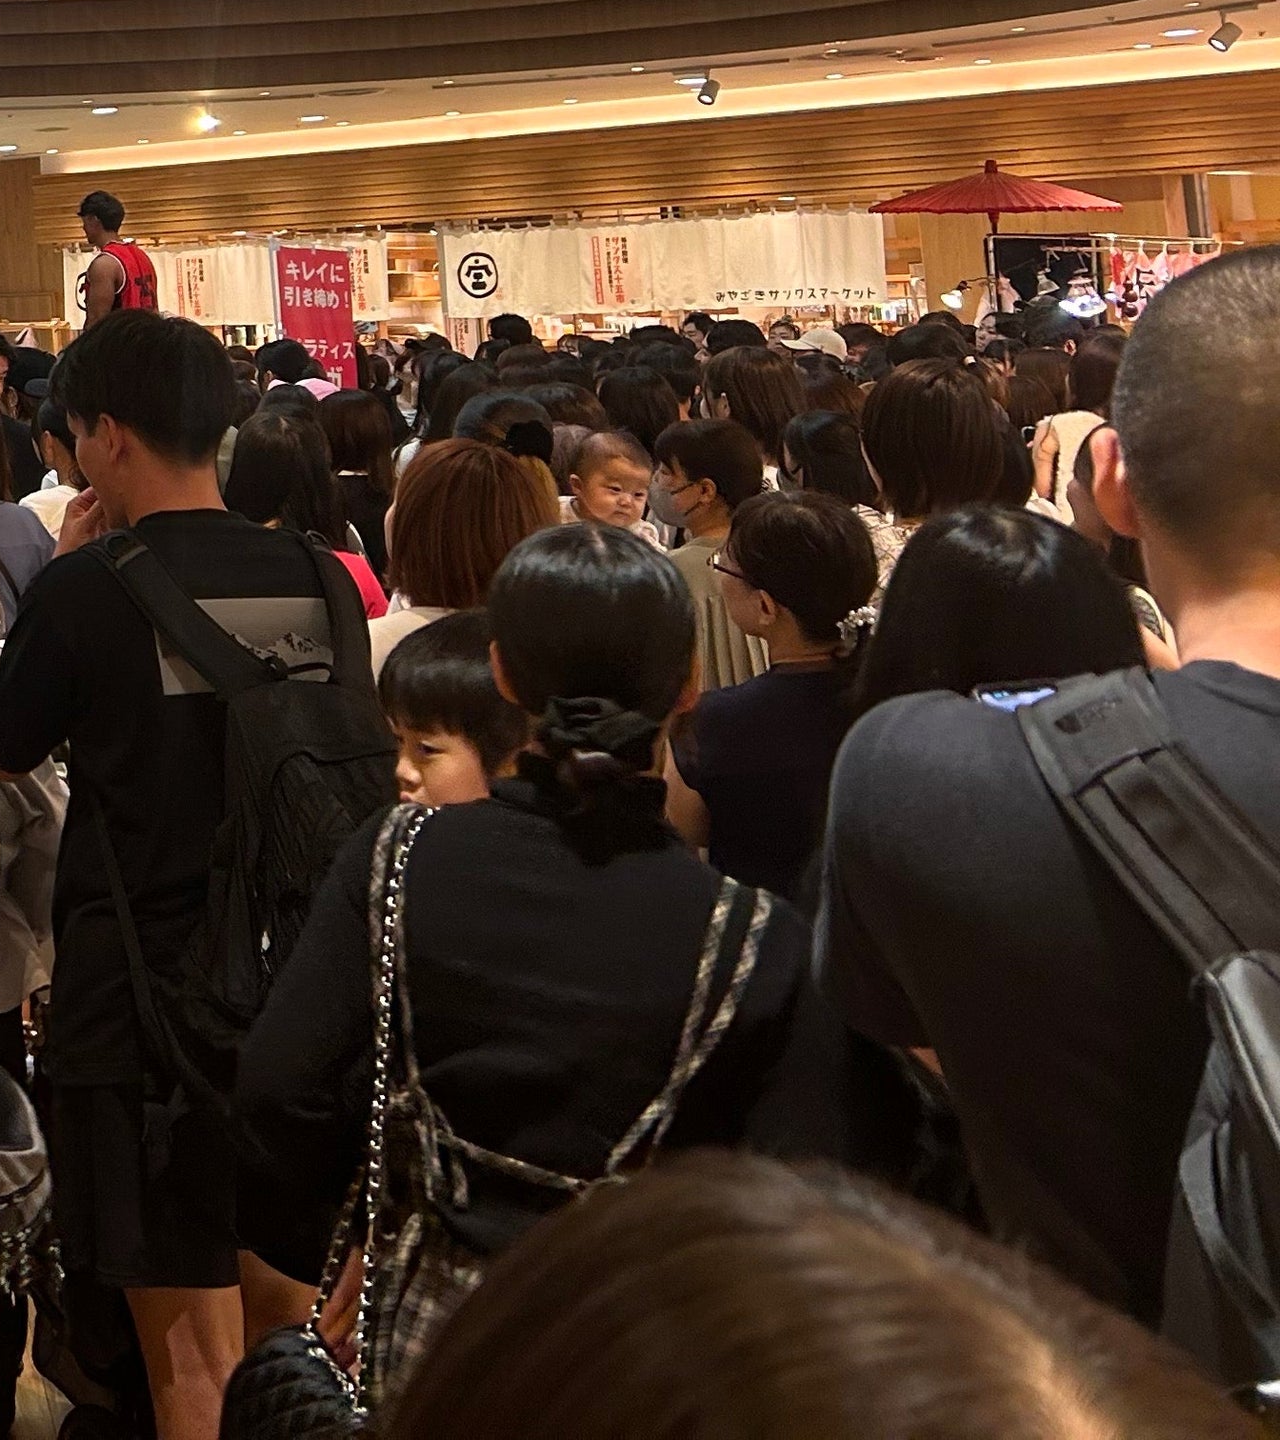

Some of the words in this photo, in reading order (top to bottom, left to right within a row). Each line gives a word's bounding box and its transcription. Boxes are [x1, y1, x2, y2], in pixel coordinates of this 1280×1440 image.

[286, 260, 345, 284] キレイに
[284, 286, 350, 310] 引き締め！
[297, 338, 354, 359] ラティス
